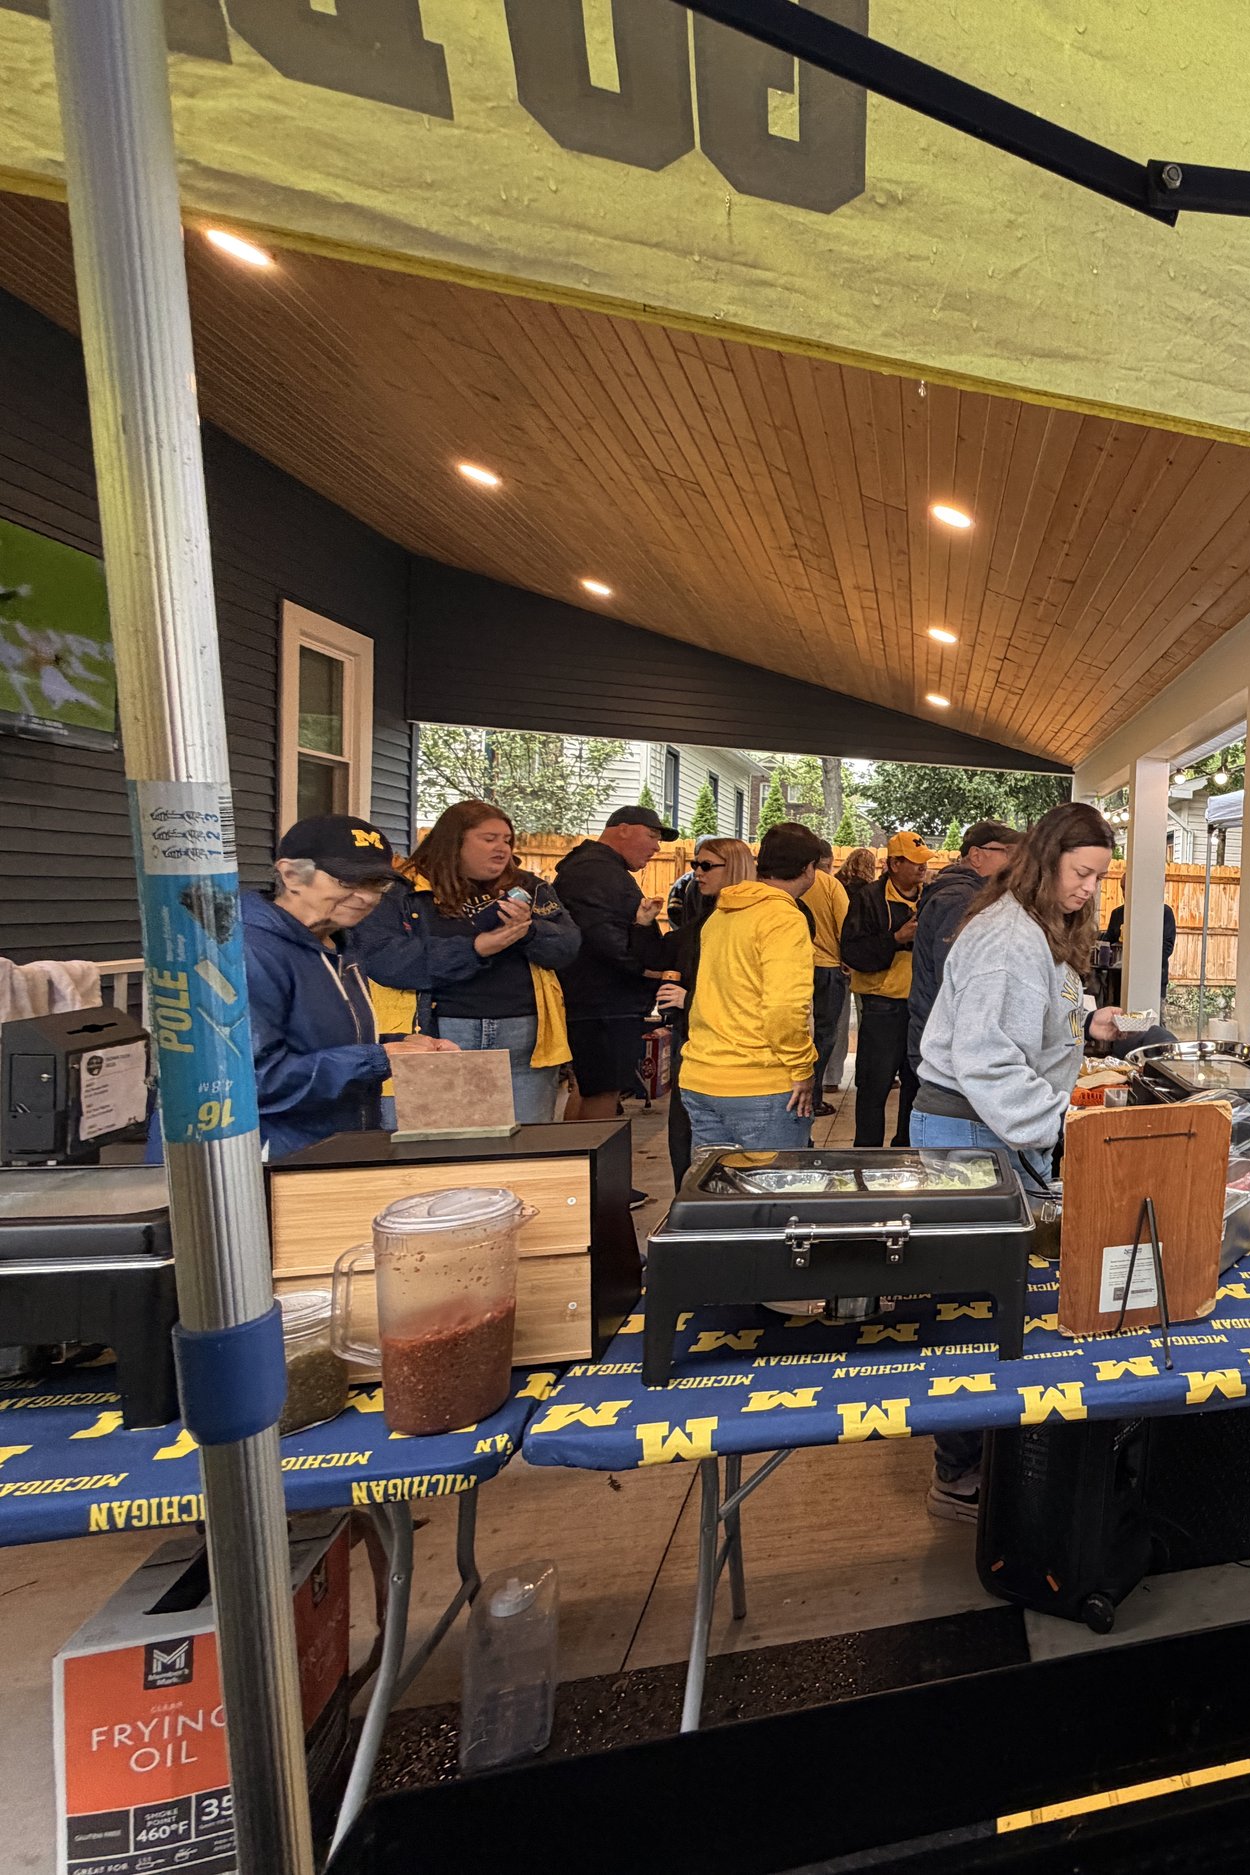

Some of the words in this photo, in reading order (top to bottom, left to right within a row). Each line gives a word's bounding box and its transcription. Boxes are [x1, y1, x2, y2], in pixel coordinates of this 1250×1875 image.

[205, 812, 220, 823] 3
[206, 830, 221, 841] 2
[351, 828, 384, 850] M
[152, 967, 195, 1053] POLE
[936, 1301, 993, 1321] M
[688, 1329, 764, 1353] M
[856, 1323, 920, 1344] M
[567, 1362, 643, 1377] CHIGAN
[752, 1352, 847, 1367] MICHIGAN
[832, 1362, 927, 1379] MICHIGAN
[1091, 1355, 1160, 1381] M
[647, 1374, 755, 1391] MICHIGA
[927, 1373, 997, 1397] M
[1179, 1368, 1247, 1405] M
[740, 1386, 824, 1413] M
[1017, 1381, 1088, 1426] M
[530, 1399, 633, 1434] M
[837, 1398, 911, 1444] M
[635, 1416, 718, 1467] M
[281, 1450, 373, 1472] MICHIG
[0, 1472, 129, 1498] MICHIGA
[351, 1474, 478, 1506] MICHIGAN
[88, 1493, 206, 1532] ICHIGAN
[129, 1740, 198, 1773] OIL
[144, 1807, 179, 1822] SMOKE
[146, 1816, 177, 1828] POINT
